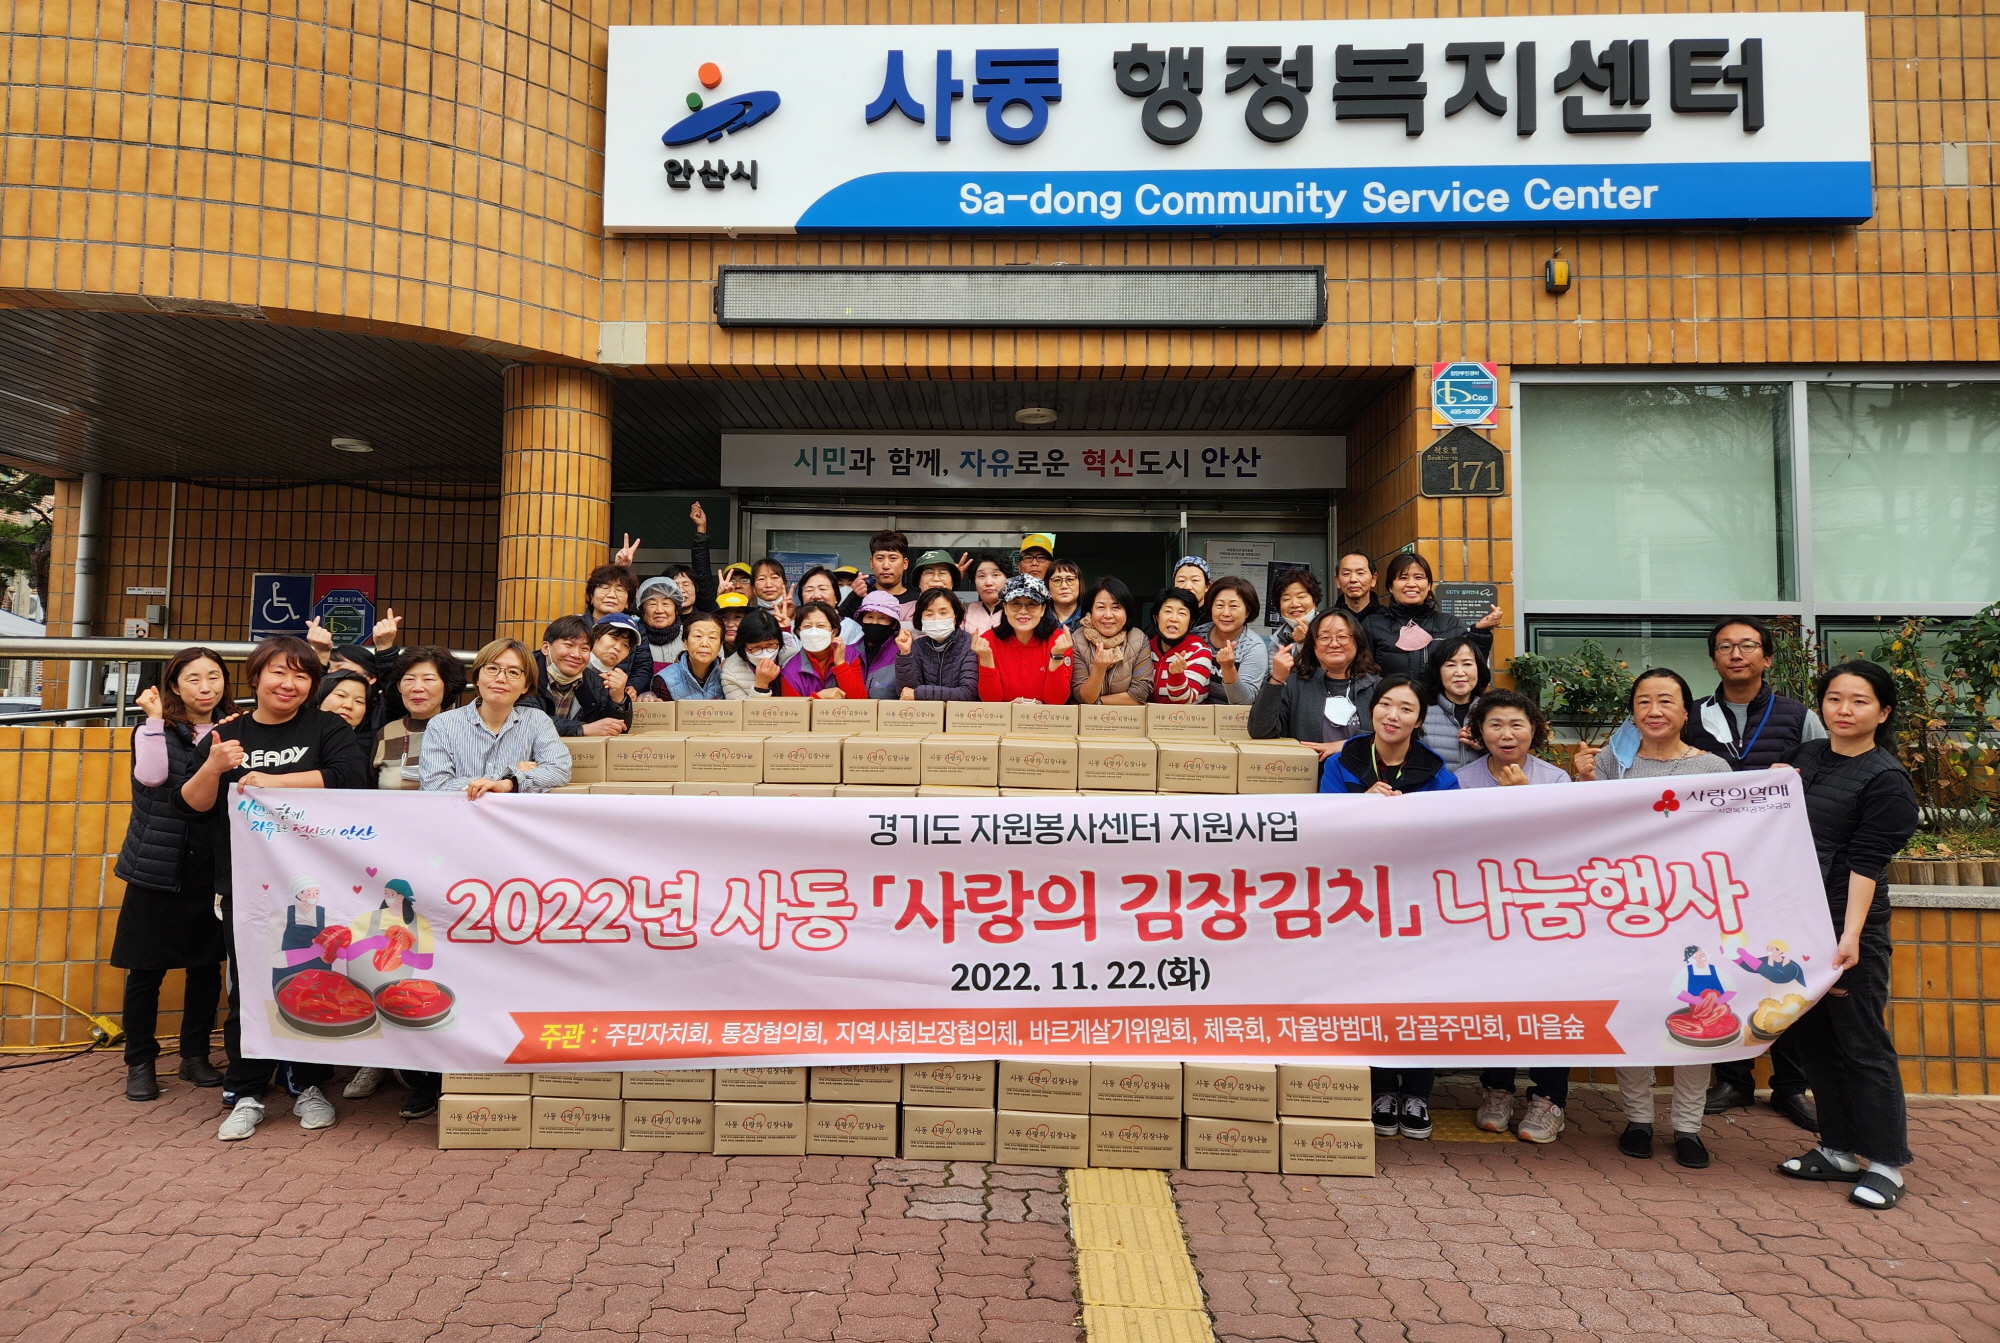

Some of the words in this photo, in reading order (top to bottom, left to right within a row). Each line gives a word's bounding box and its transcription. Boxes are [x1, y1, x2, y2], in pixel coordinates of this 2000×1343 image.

[865, 48, 1062, 146] 사동
[1113, 38, 1765, 146] 행정복지센터
[664, 158, 759, 191] 안산시
[959, 183, 1122, 220] Sa-dong
[1135, 180, 1348, 221] Community
[1362, 179, 1510, 215] Service
[1522, 177, 1659, 211] Center
[793, 446, 876, 478] 시민과
[887, 446, 949, 478] 함께,
[958, 447, 1070, 478] 자유로운
[1081, 447, 1189, 478] 혁신도시
[1200, 446, 1262, 478] 안산
[1447, 461, 1500, 491] 171
[234, 746, 310, 769] READY
[1685, 784, 1790, 807] 사랑의열매
[868, 811, 962, 847] 경기도
[969, 811, 1162, 846] 자원봉사센터
[1169, 809, 1299, 845] 지원사업
[446, 870, 701, 951] 2022년
[710, 869, 858, 952] 사동
[1432, 850, 1750, 942] 나눔행사
[950, 962, 1041, 993] 2022.
[1051, 961, 1098, 991] 11.
[1106, 956, 1211, 992] 22.(화)
[538, 1022, 586, 1050] 주관
[604, 1021, 713, 1049] 주민자치회,
[720, 1019, 828, 1047] 통장협의회,
[835, 1017, 1023, 1047] 지역사회보장협의체,
[1029, 1016, 1198, 1046] 바르게살기위원회,
[1203, 1016, 1271, 1045] 체육회,
[1277, 1015, 1389, 1044] 자율방범대,
[1395, 1014, 1511, 1043] 감골주민회,
[1517, 1012, 1586, 1041] 마을숲
